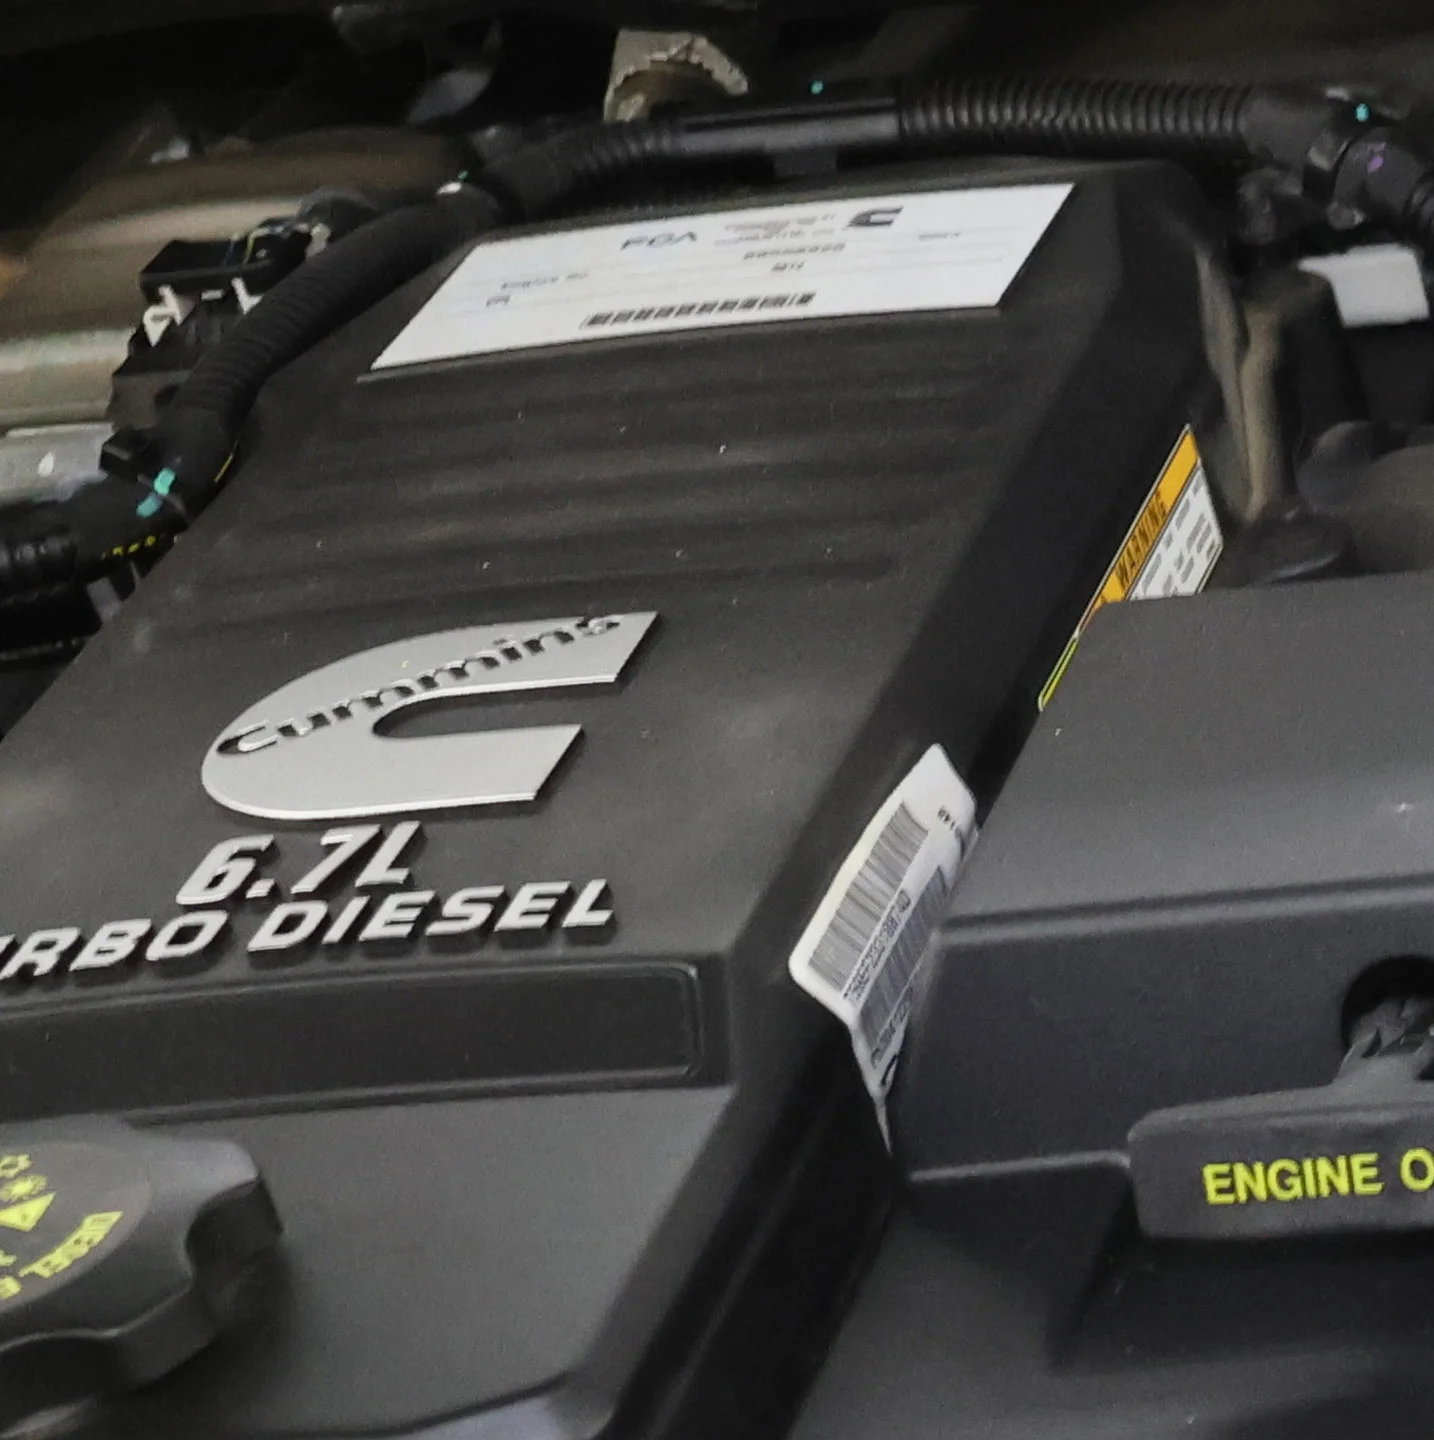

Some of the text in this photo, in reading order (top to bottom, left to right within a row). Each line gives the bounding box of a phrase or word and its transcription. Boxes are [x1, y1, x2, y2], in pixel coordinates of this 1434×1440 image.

[1115, 489, 1167, 591] WARNING
[216, 614, 624, 755] Cummins
[176, 820, 421, 905] 6.7L
[0, 878, 615, 981] RBO DIESEL
[1201, 1151, 1385, 1205] ENGINE
